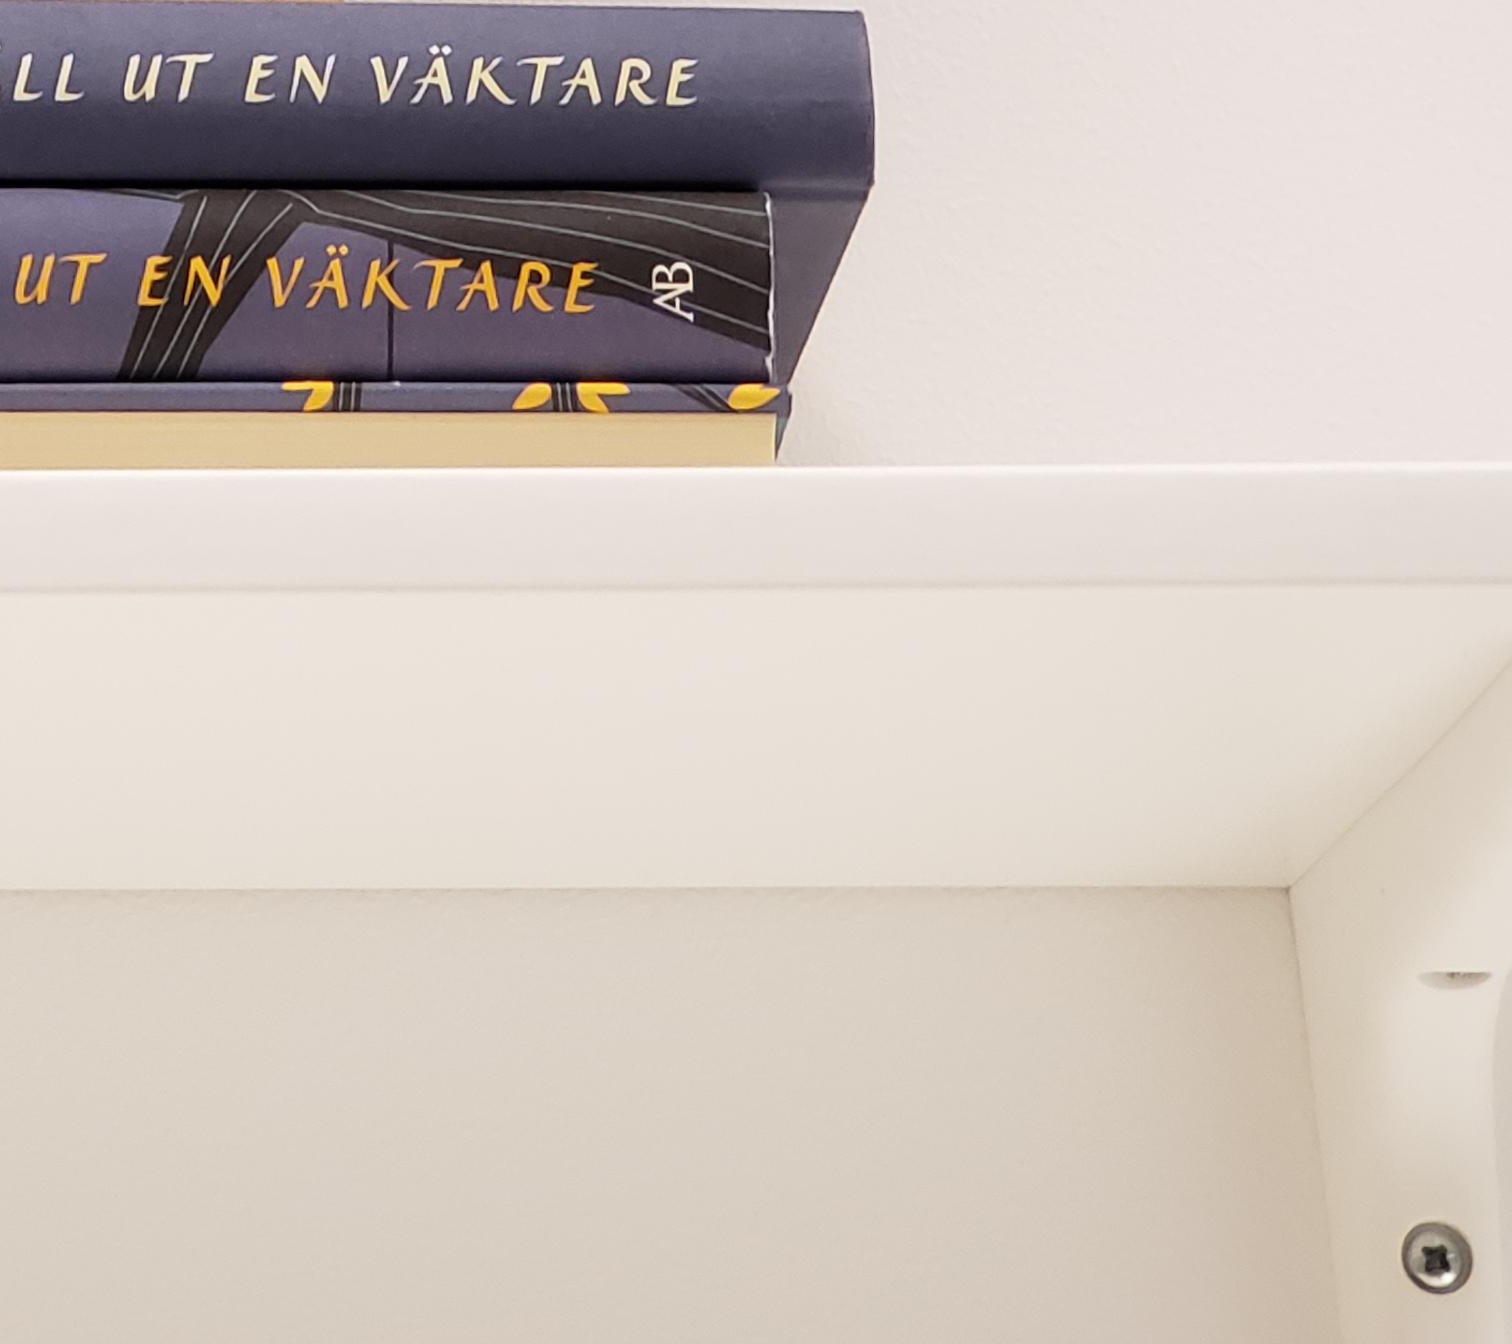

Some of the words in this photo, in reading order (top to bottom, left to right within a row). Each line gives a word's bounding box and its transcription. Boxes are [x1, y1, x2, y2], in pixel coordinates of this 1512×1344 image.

[123, 52, 215, 104] UT
[243, 52, 338, 105] EN
[369, 44, 702, 107] VÄKTARE
[14, 252, 106, 306] UT
[137, 255, 231, 309] EN
[266, 244, 599, 313] VÄKTARE
